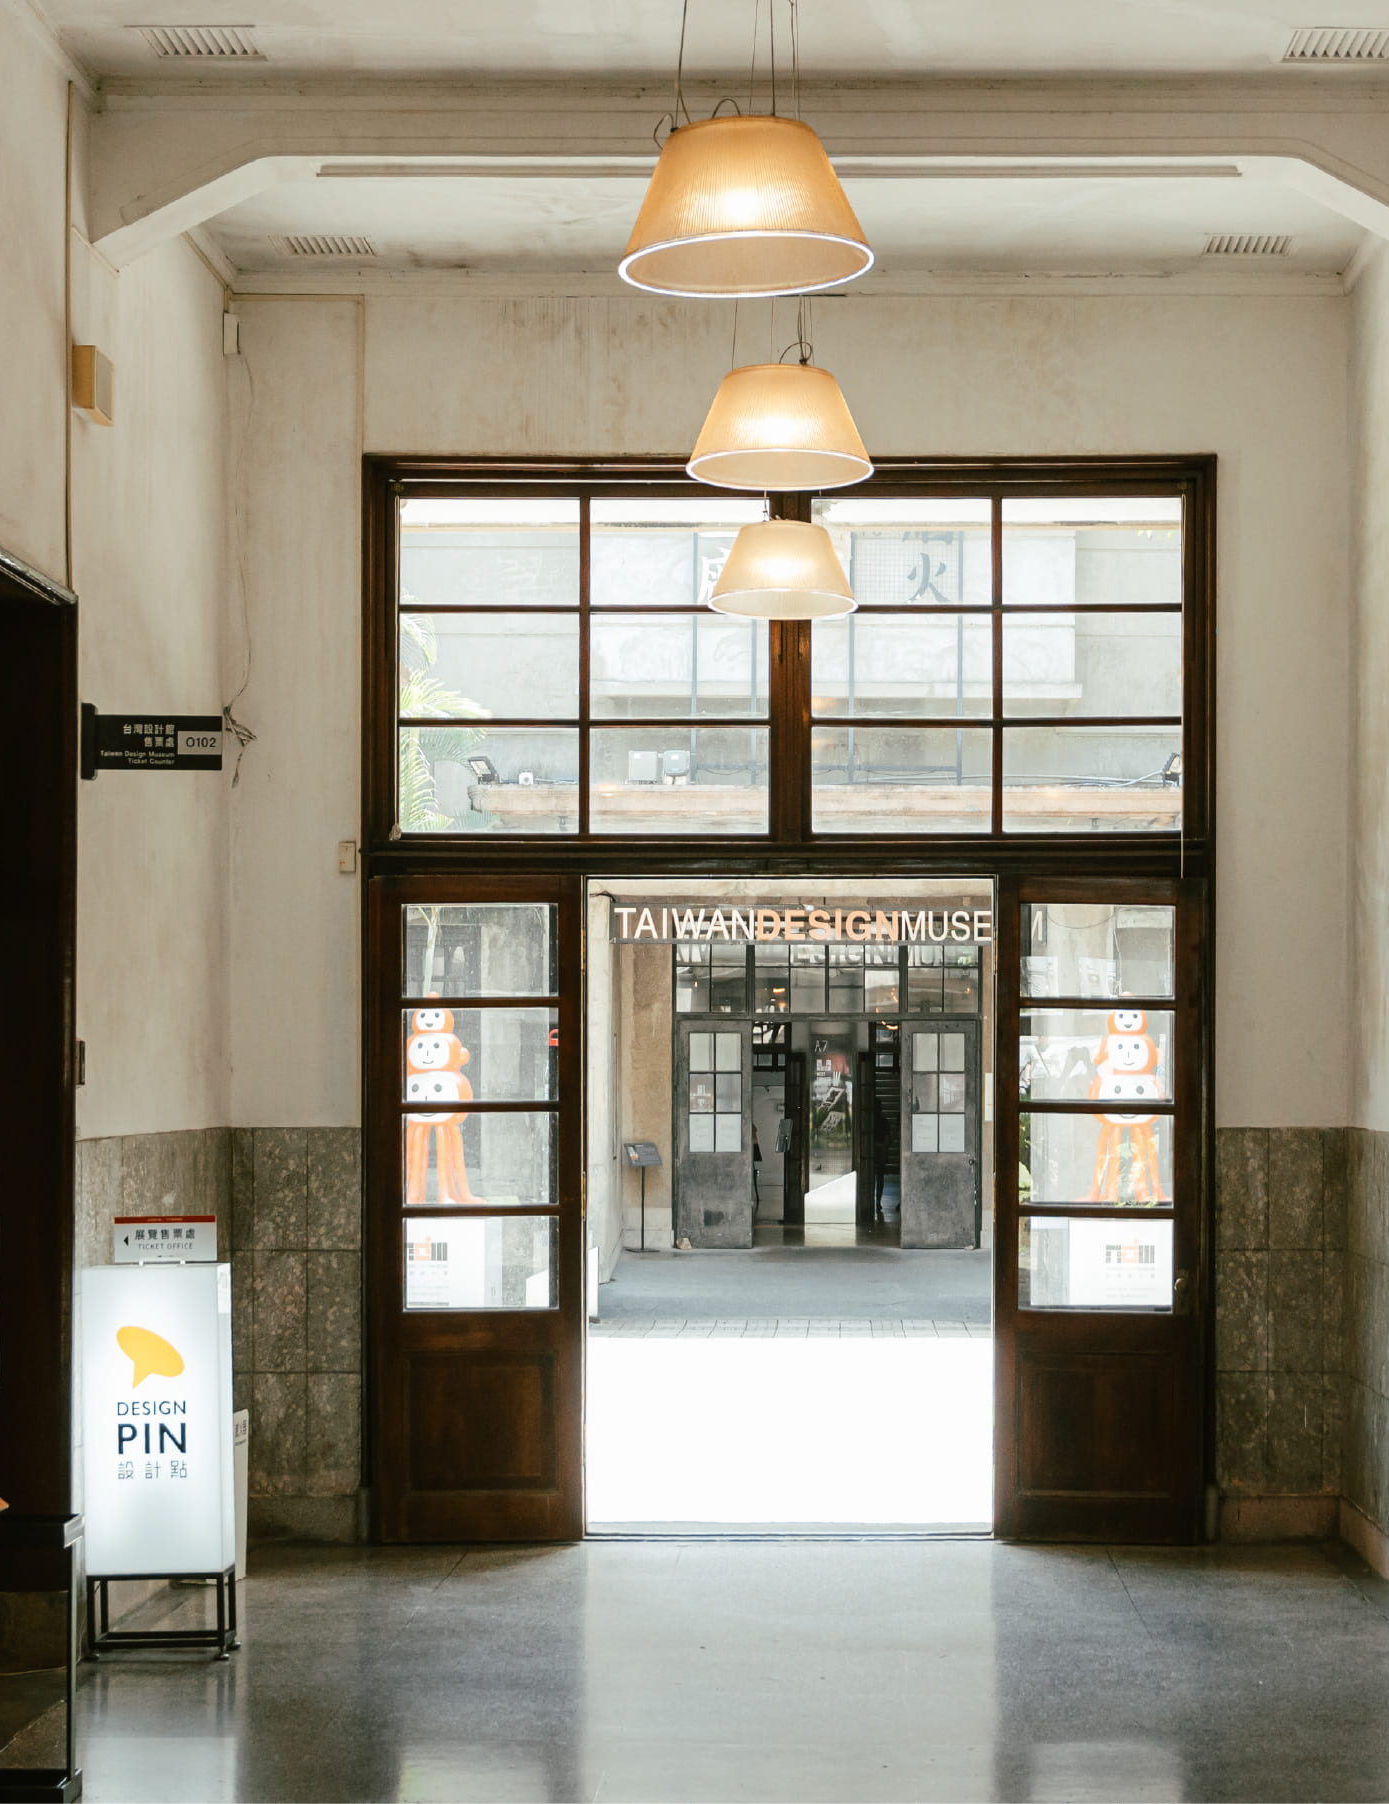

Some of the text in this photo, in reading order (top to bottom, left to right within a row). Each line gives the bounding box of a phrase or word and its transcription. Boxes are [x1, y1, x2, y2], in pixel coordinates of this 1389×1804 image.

[135, 1228, 195, 1240] 展覽售票處
[117, 1401, 186, 1415] DESIGN
[118, 1423, 186, 1454] PIN
